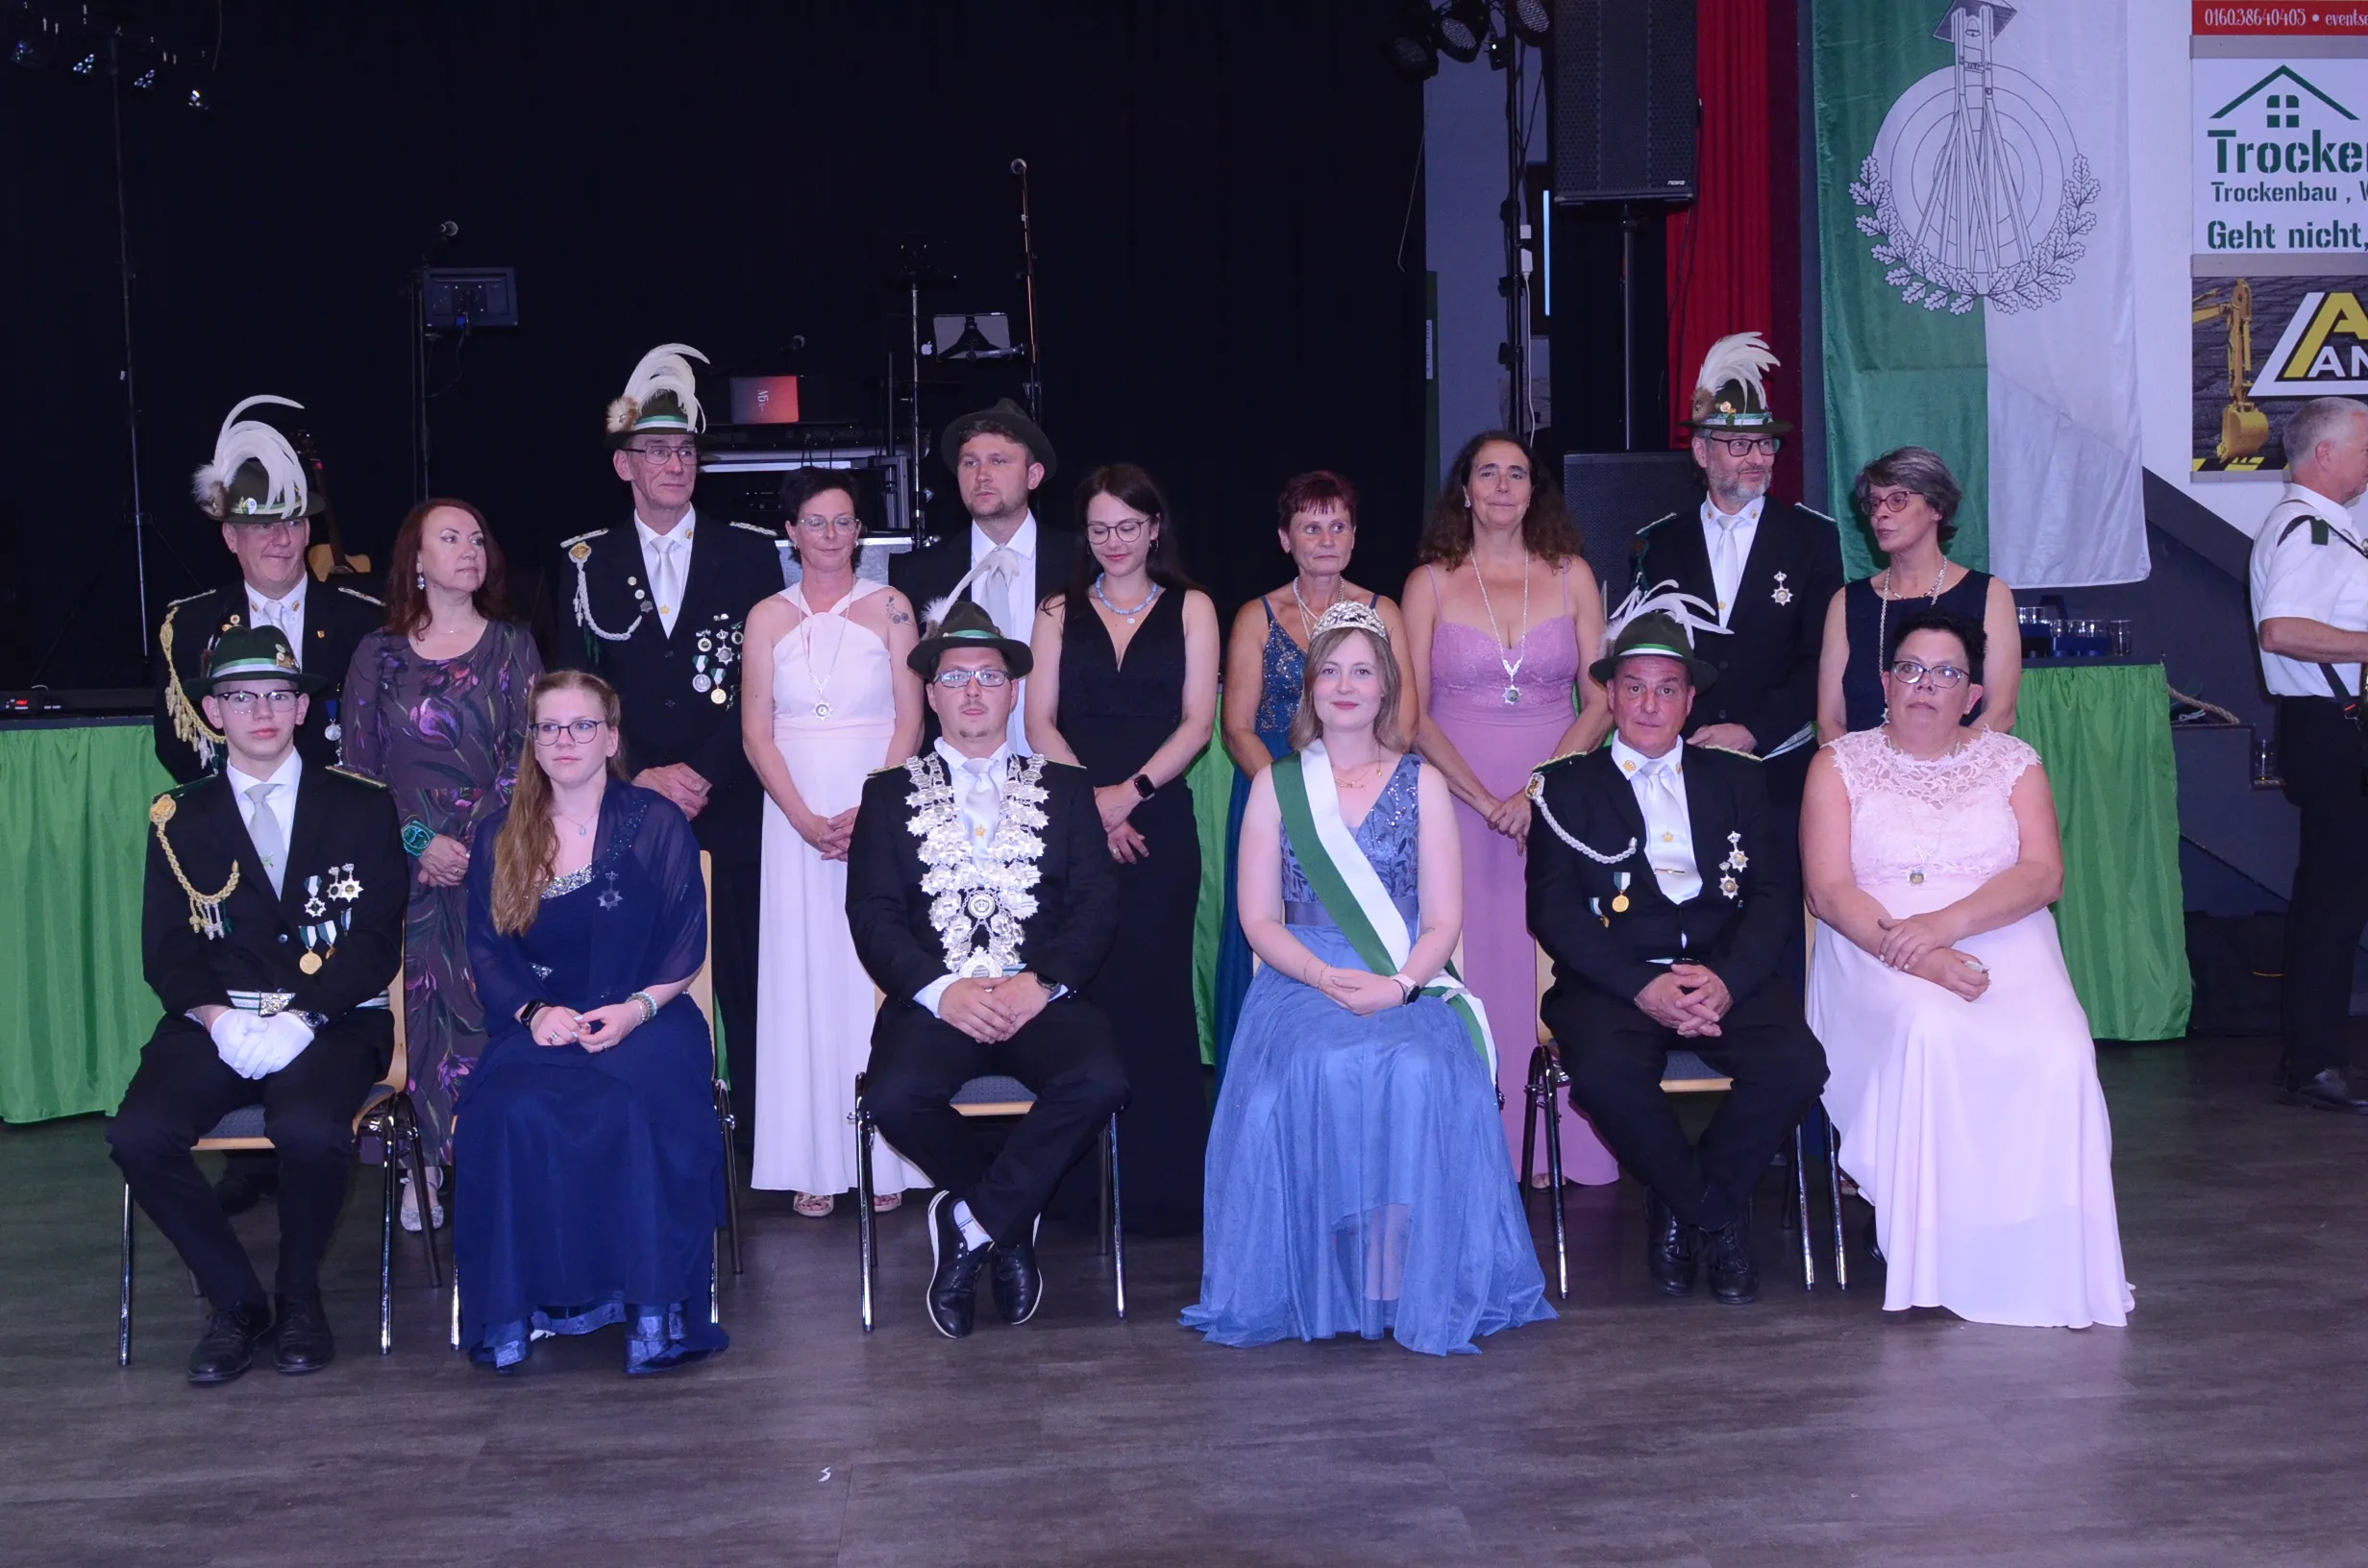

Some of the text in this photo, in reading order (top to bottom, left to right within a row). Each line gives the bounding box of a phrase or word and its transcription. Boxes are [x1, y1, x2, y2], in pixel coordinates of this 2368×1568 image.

[2207, 129, 2368, 173] Trocke
[2210, 181, 2337, 202] Trockenbau
[2207, 219, 2368, 251] Geht nicht,
